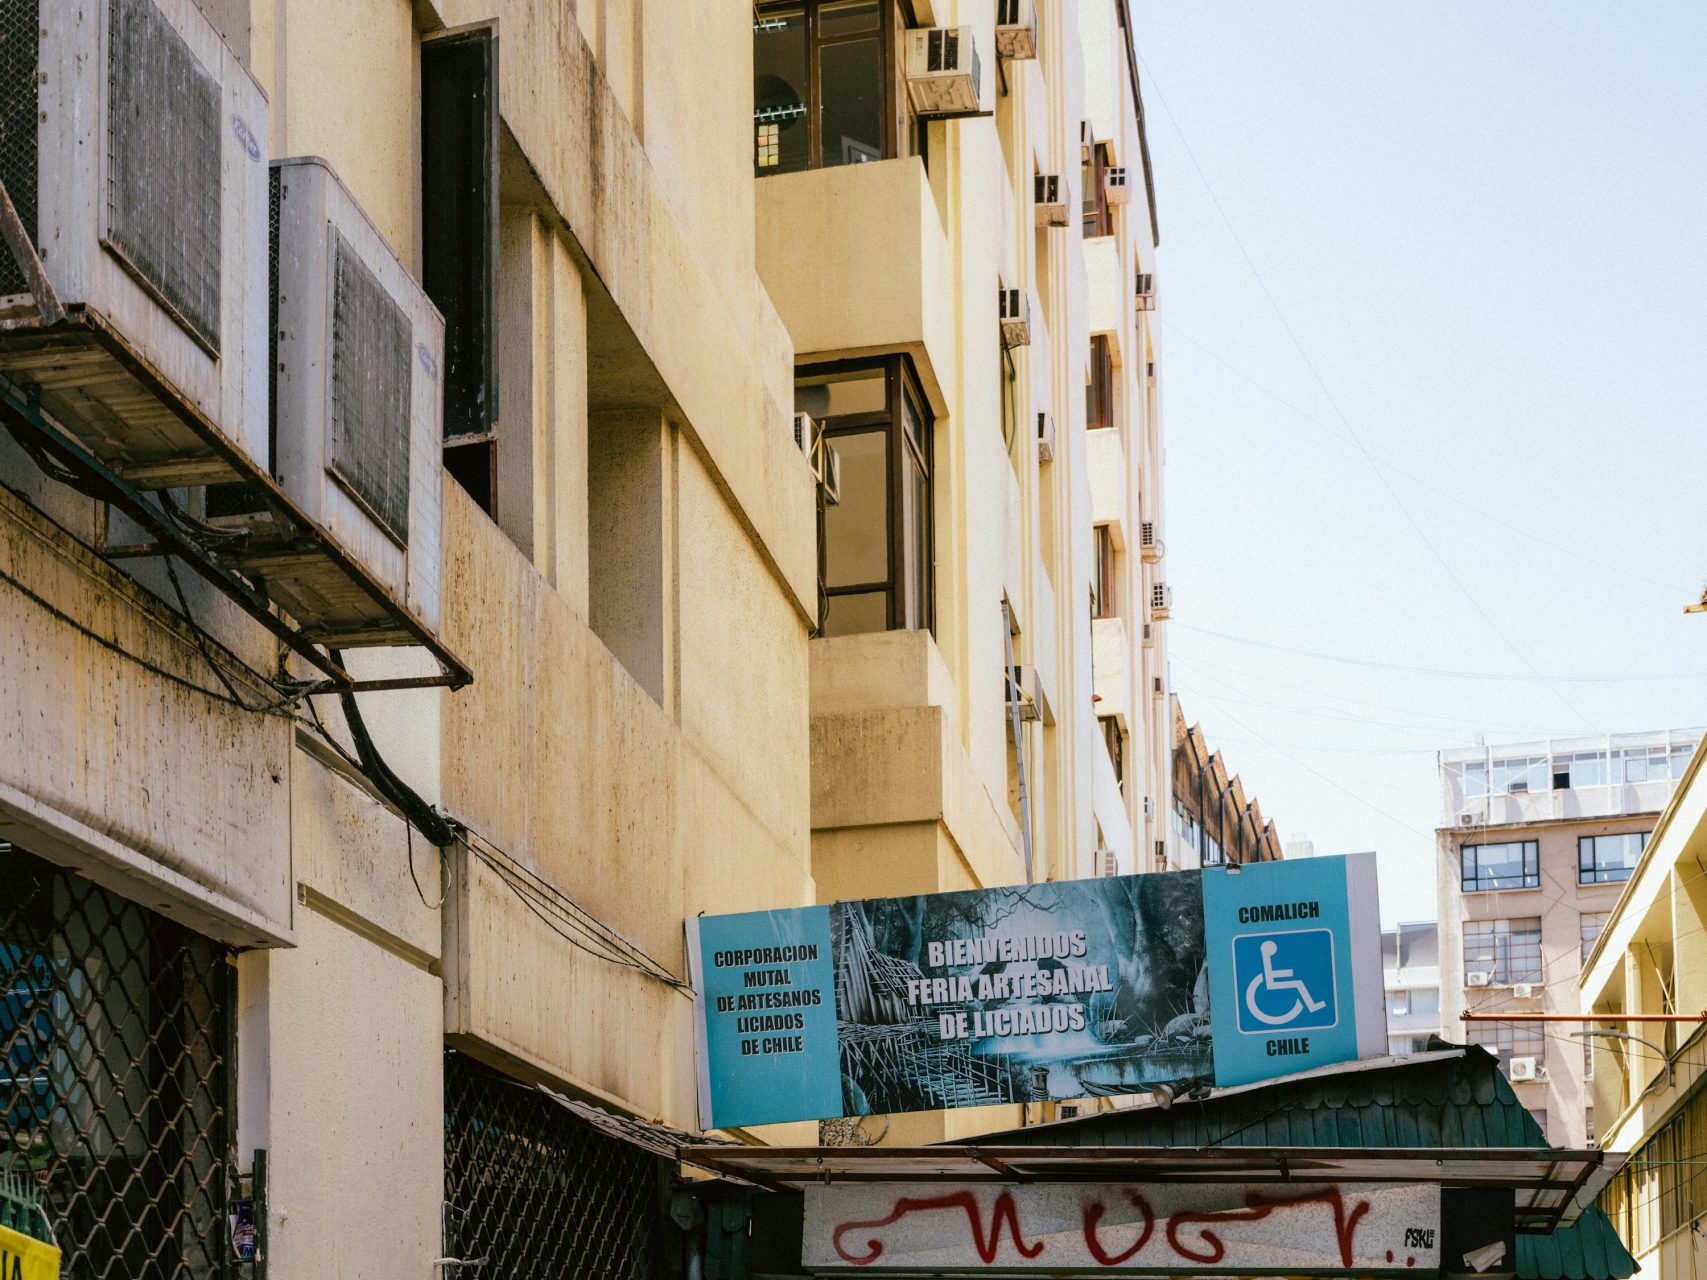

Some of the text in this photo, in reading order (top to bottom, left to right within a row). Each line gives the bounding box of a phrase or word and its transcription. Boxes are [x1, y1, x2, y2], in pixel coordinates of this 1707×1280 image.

[1239, 902, 1319, 923] COMALICH
[714, 944, 819, 968] CORPORACION
[928, 930, 1088, 968] BIENVENIDOS
[744, 969, 792, 988] MUTAL
[908, 965, 1113, 1006] FERIA ARTESANAL
[717, 989, 823, 1013] DE ARTESANOS
[737, 1013, 805, 1034] LICIADOS
[940, 1004, 1085, 1041] DE LICIADOS
[742, 1036, 803, 1056] DE CHILE
[1266, 1038, 1310, 1057] CHILE
